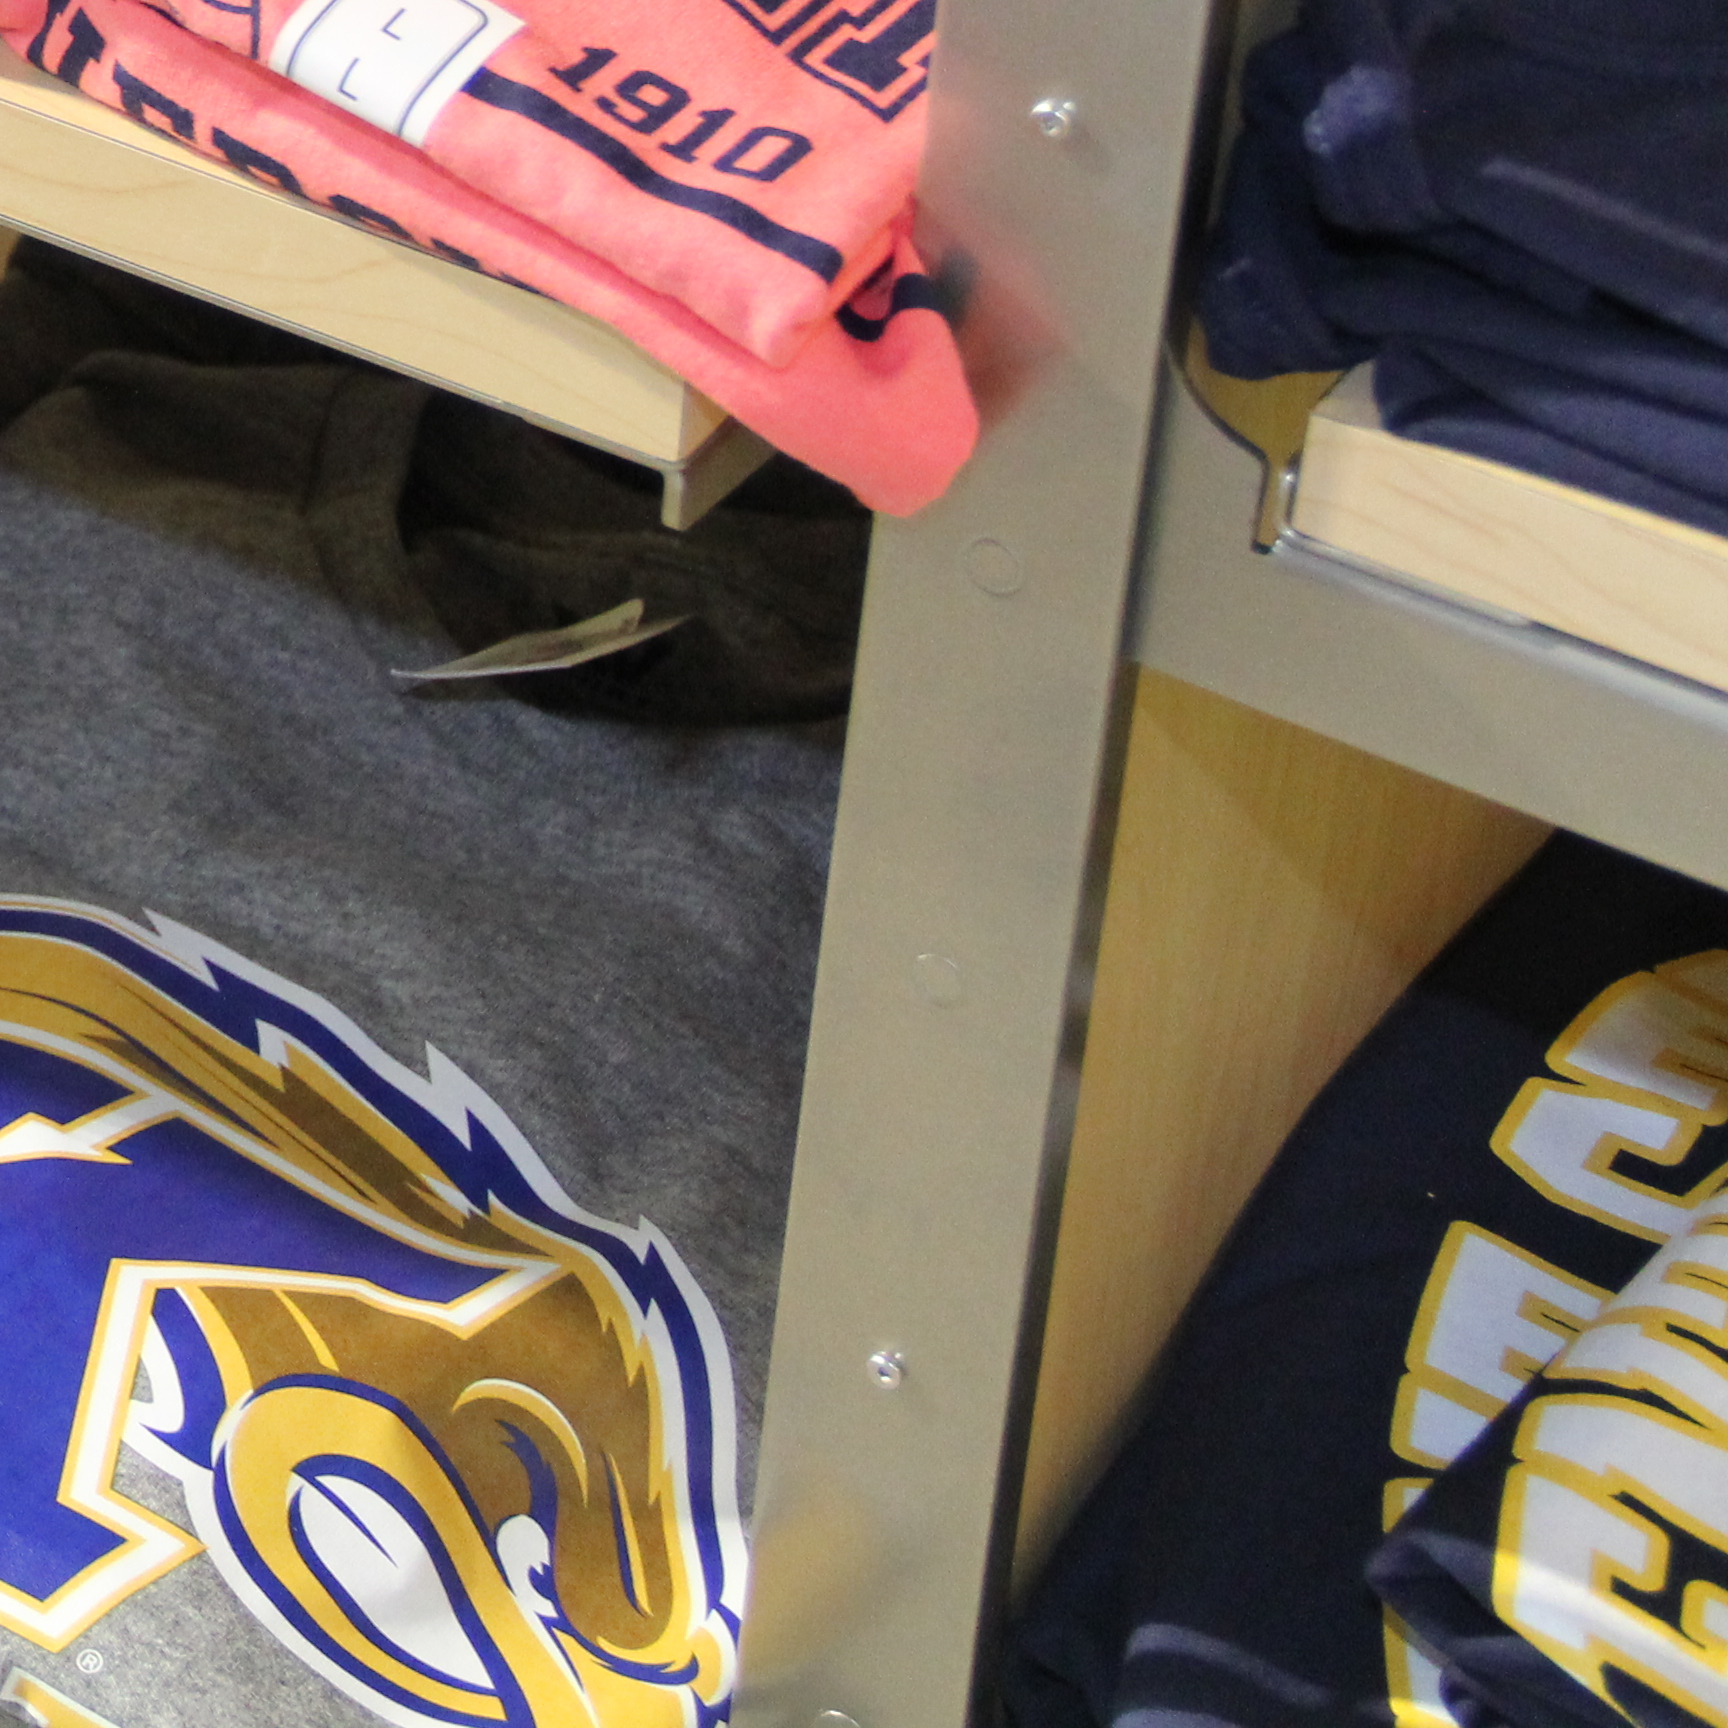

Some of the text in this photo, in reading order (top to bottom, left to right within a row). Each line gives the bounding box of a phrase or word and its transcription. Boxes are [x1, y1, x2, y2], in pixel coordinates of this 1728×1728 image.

[382, 7, 410, 42] L
[338, 57, 359, 102] L
[547, 43, 813, 185] 1910
